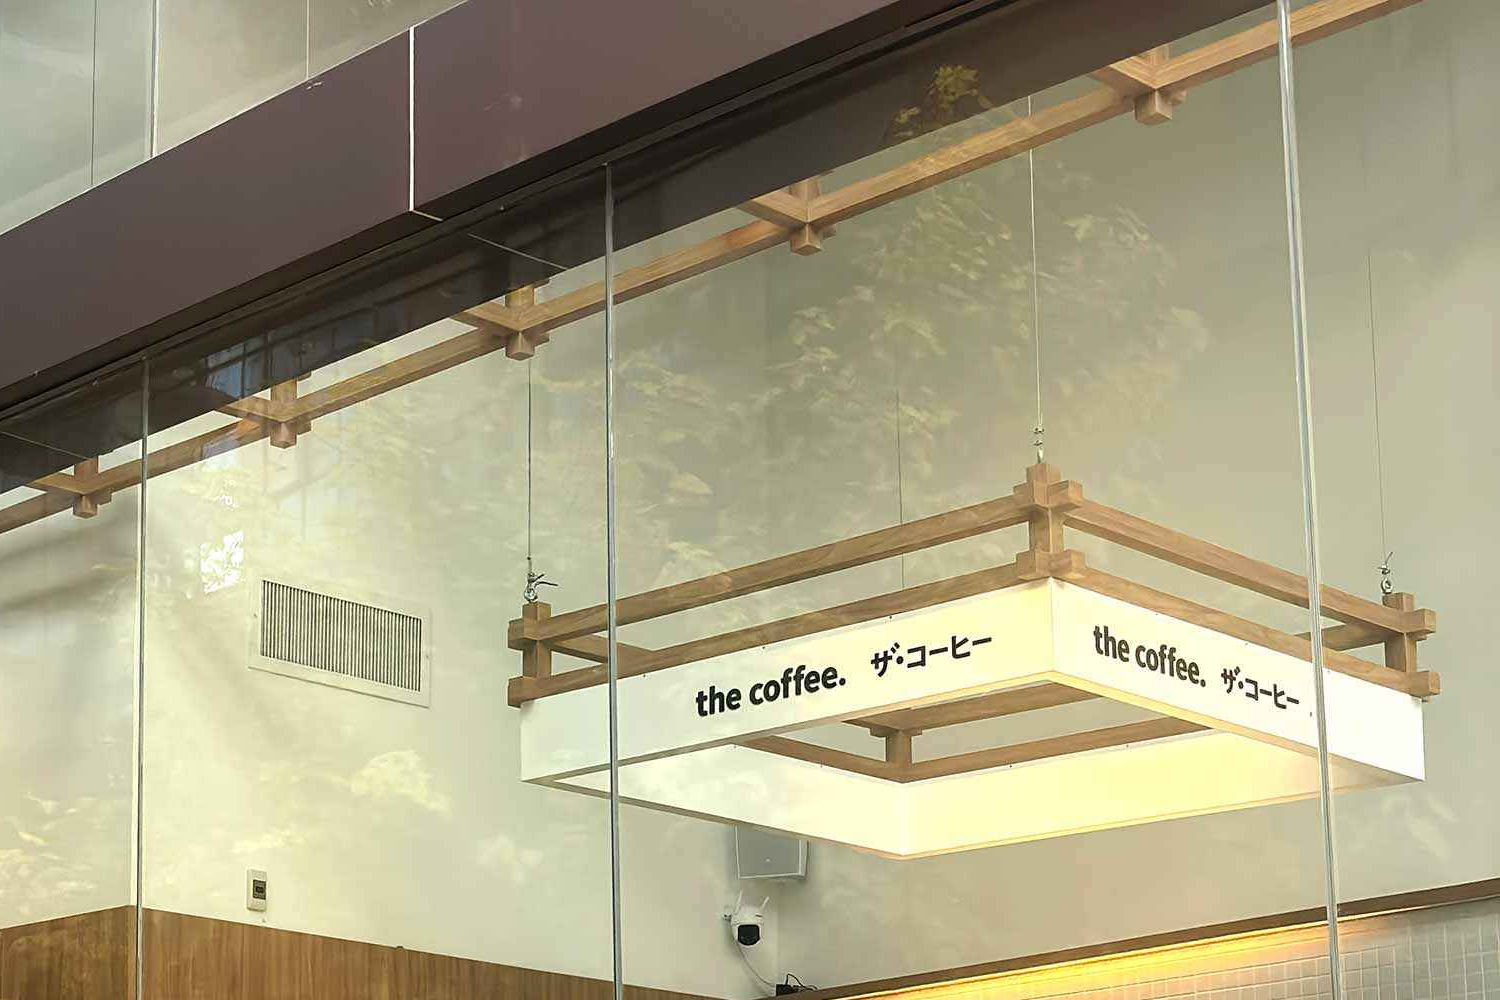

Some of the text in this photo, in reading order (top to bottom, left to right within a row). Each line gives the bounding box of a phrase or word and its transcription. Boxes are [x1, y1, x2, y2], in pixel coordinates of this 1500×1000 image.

[870, 635, 993, 678] ザ・コーヒー
[1093, 625, 1206, 687] the coffee.
[695, 664, 846, 717] the coffee.
[1221, 666, 1300, 709] ザ・コーヒー
